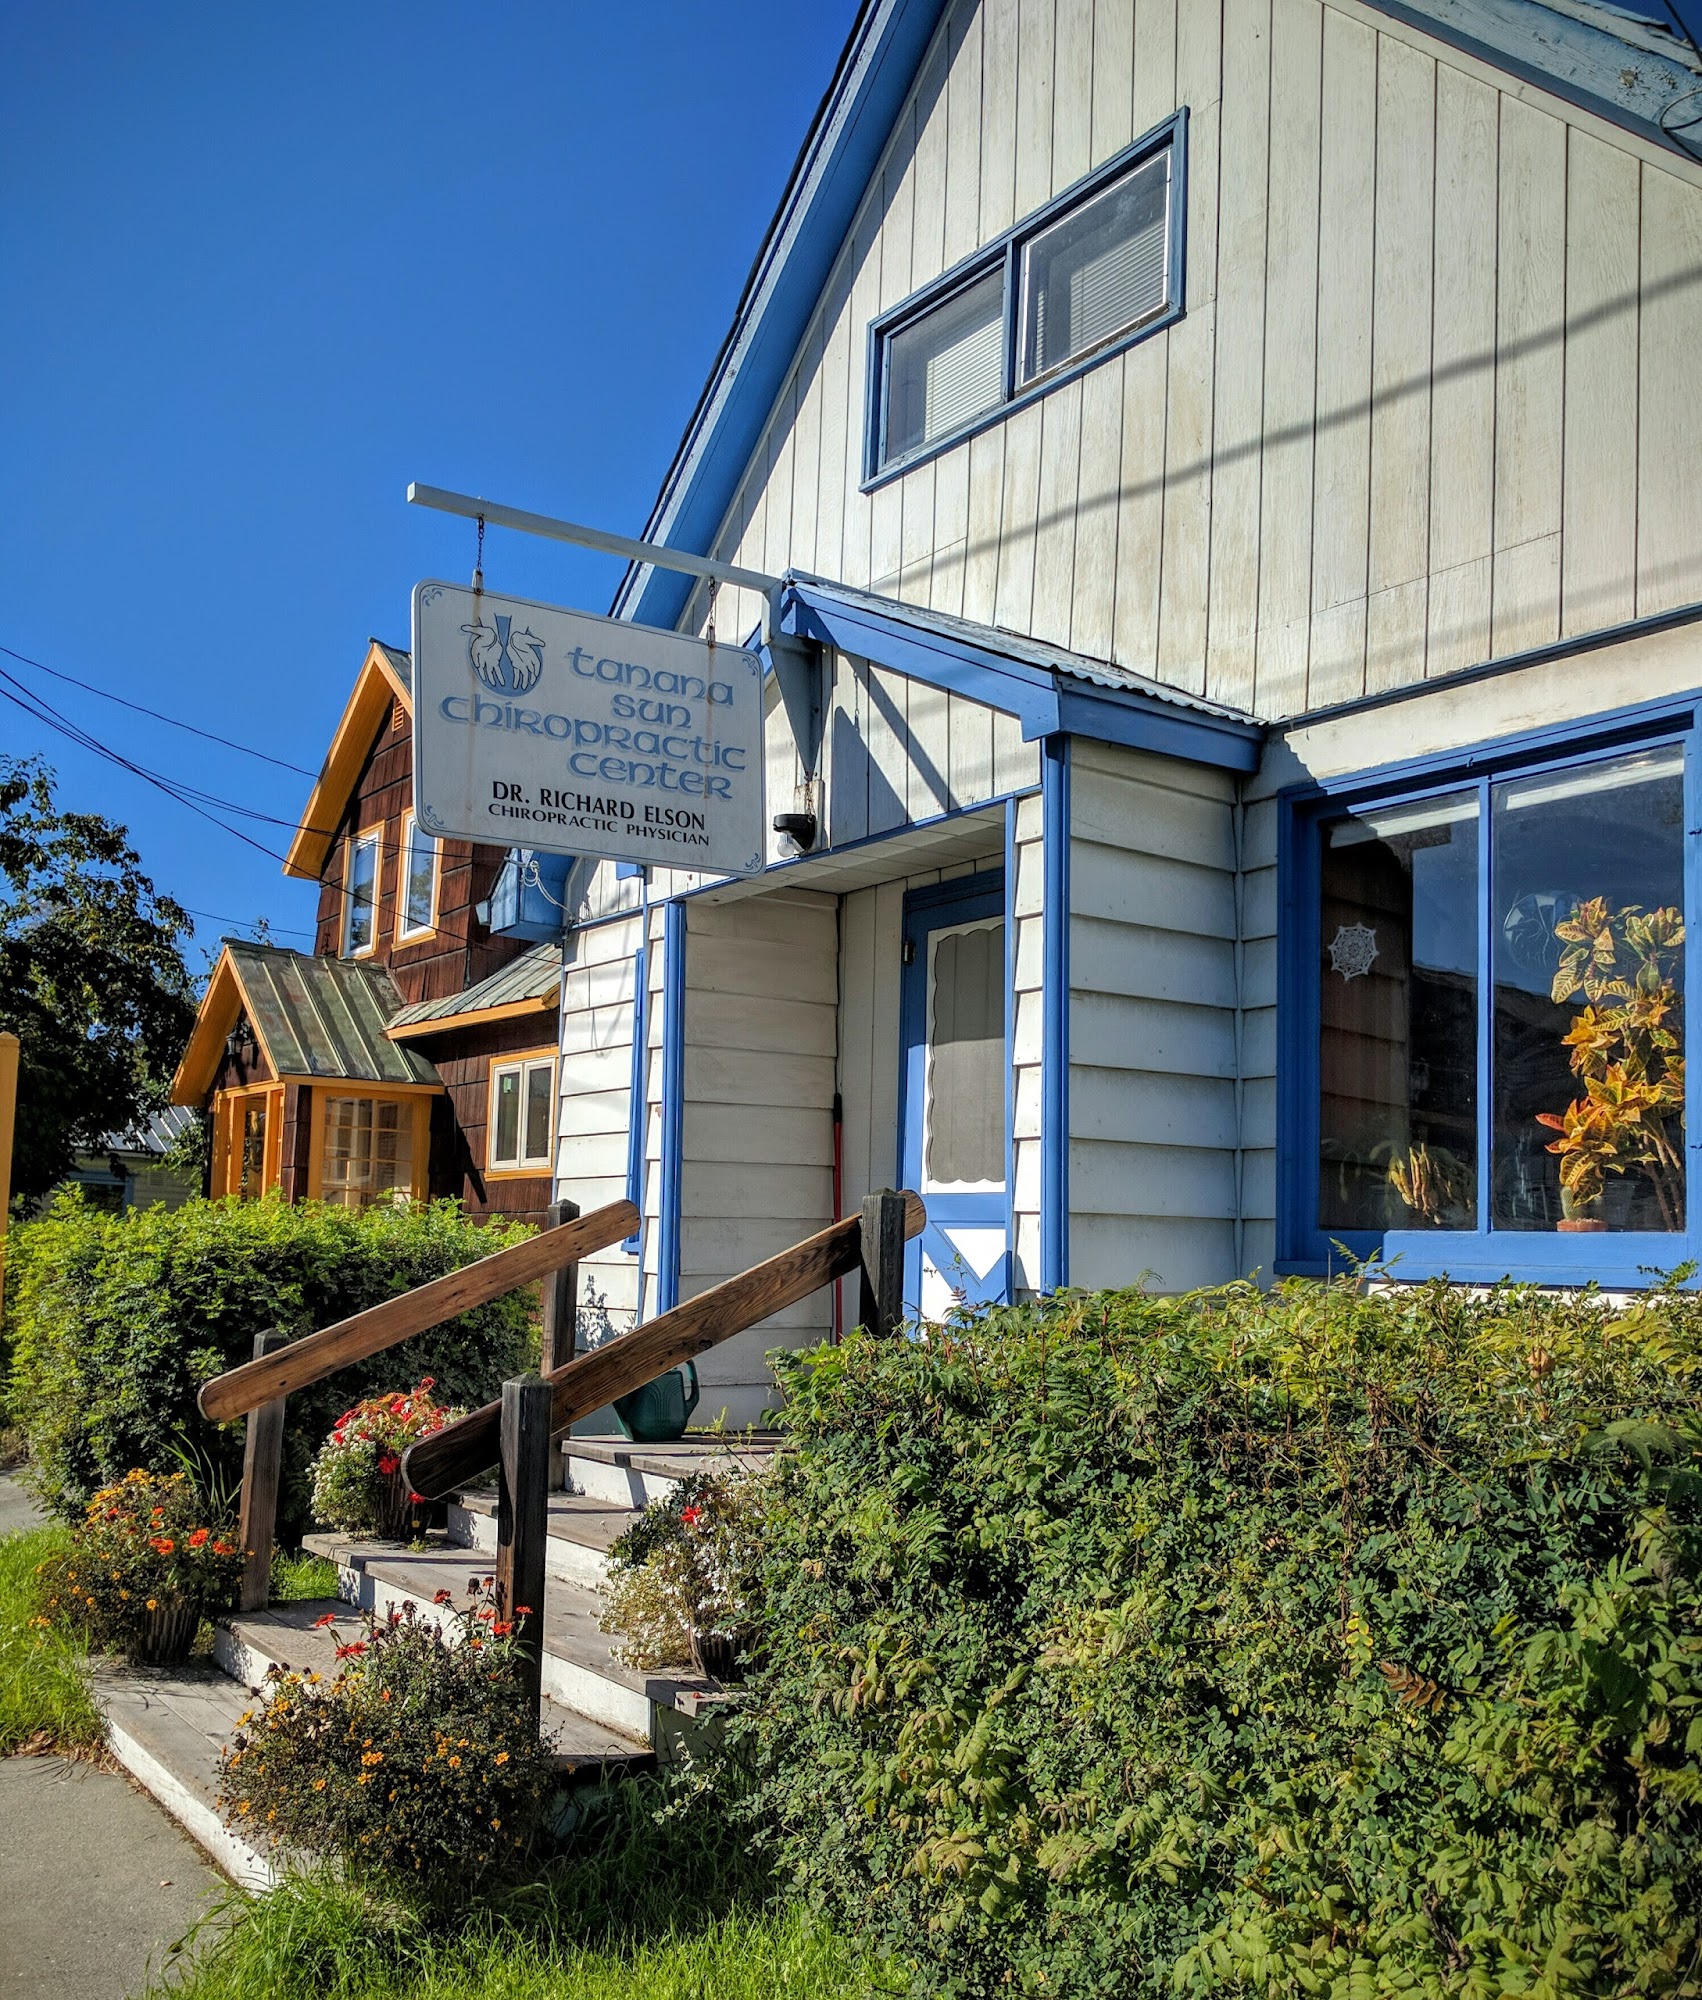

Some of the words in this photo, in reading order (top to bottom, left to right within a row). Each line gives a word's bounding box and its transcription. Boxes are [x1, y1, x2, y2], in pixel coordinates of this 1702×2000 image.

[612, 693, 691, 728] sun
[488, 803, 618, 833] CHIROPRACTIC
[626, 823, 710, 846] PHYSICIAN
[492, 780, 530, 804] DR.
[540, 788, 635, 819] RICHARD
[644, 805, 706, 831] ELSON
